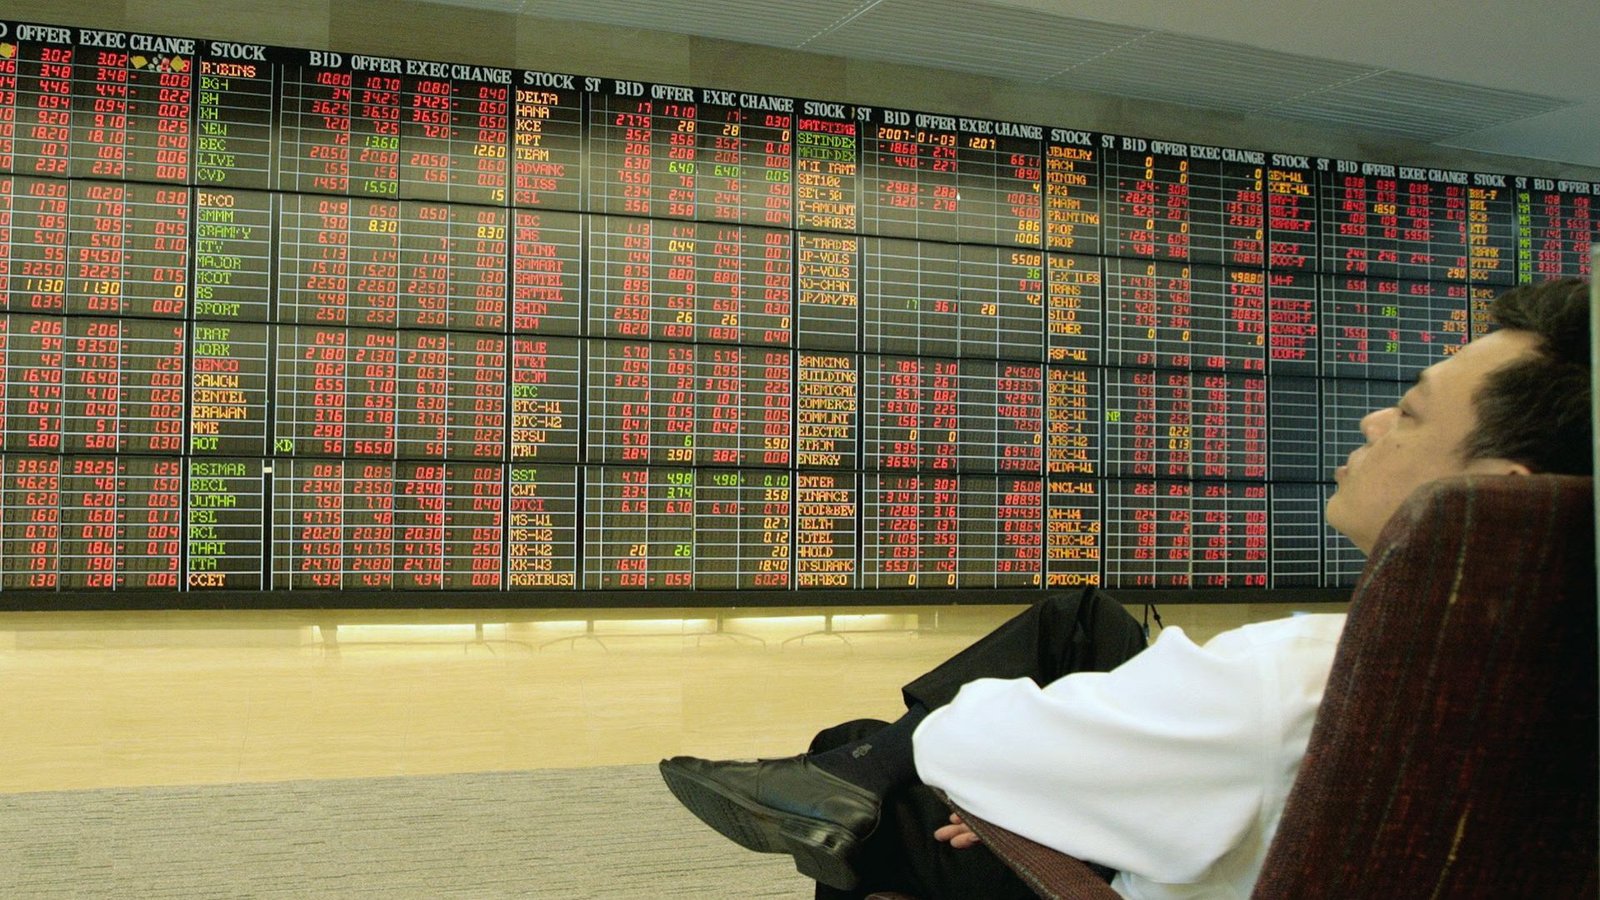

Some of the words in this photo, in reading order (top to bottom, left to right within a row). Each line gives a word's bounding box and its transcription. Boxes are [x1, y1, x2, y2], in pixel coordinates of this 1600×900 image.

[16, 24, 71, 44] OFFER
[80, 30, 126, 48] EXEC
[130, 34, 195, 54] CHANGE
[211, 42, 266, 61] STOCK
[310, 51, 342, 68] BID
[351, 56, 401, 74] OFFER
[406, 62, 449, 78] EXEC
[452, 67, 512, 84] CHANGE
[524, 71, 574, 90] STOCK
[585, 78, 601, 92] ST
[616, 80, 644, 96] BID
[651, 85, 694, 102] OFFER
[703, 91, 736, 106] EXEC
[740, 94, 794, 112] CHANGE
[804, 102, 845, 119] STOCK
[858, 108, 871, 121] ST
[884, 110, 910, 126] BID
[915, 114, 956, 131] OFFER
[959, 119, 993, 135] EXEC
[995, 123, 1043, 139] CHANGE
[1051, 129, 1092, 146] STOCK
[1102, 136, 1115, 149] ST
[1122, 137, 1147, 152] BID
[1151, 140, 1187, 157] OFFER
[1190, 146, 1220, 160] EXEC
[1222, 148, 1265, 165] CHANGE
[1272, 154, 1309, 169] STOCK
[1317, 158, 1330, 171] ST
[1337, 160, 1358, 174] BID
[1362, 163, 1396, 177] OFFER
[1399, 167, 1427, 181] EXEC
[1428, 169, 1469, 185] CHANGE
[1474, 173, 1506, 188] STOCK
[1515, 177, 1528, 189] ST
[1534, 178, 1554, 191] BID
[1558, 181, 1590, 194] OFFER
